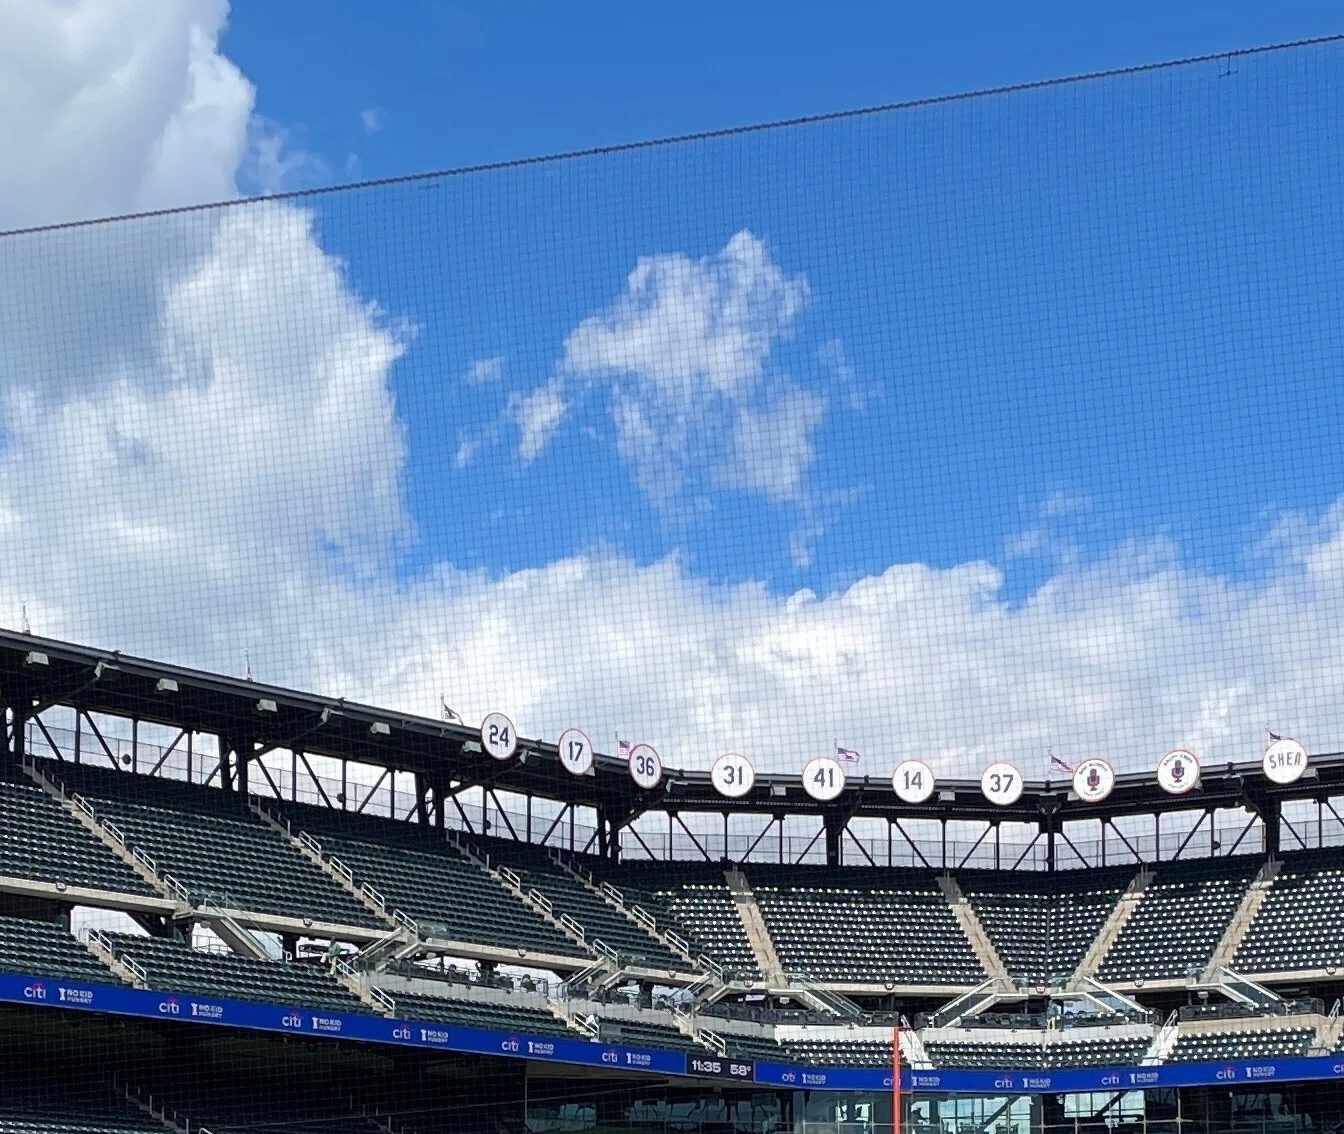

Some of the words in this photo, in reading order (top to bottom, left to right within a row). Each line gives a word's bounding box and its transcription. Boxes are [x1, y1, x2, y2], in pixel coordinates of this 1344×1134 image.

[489, 724, 510, 747] 24
[568, 741, 584, 762] 17
[636, 756, 654, 776] 36
[724, 766, 744, 786] 31
[814, 768, 834, 788] 41
[904, 770, 922, 790] 14
[990, 774, 1014, 793] 37
[692, 1060, 721, 1073] 11:35
